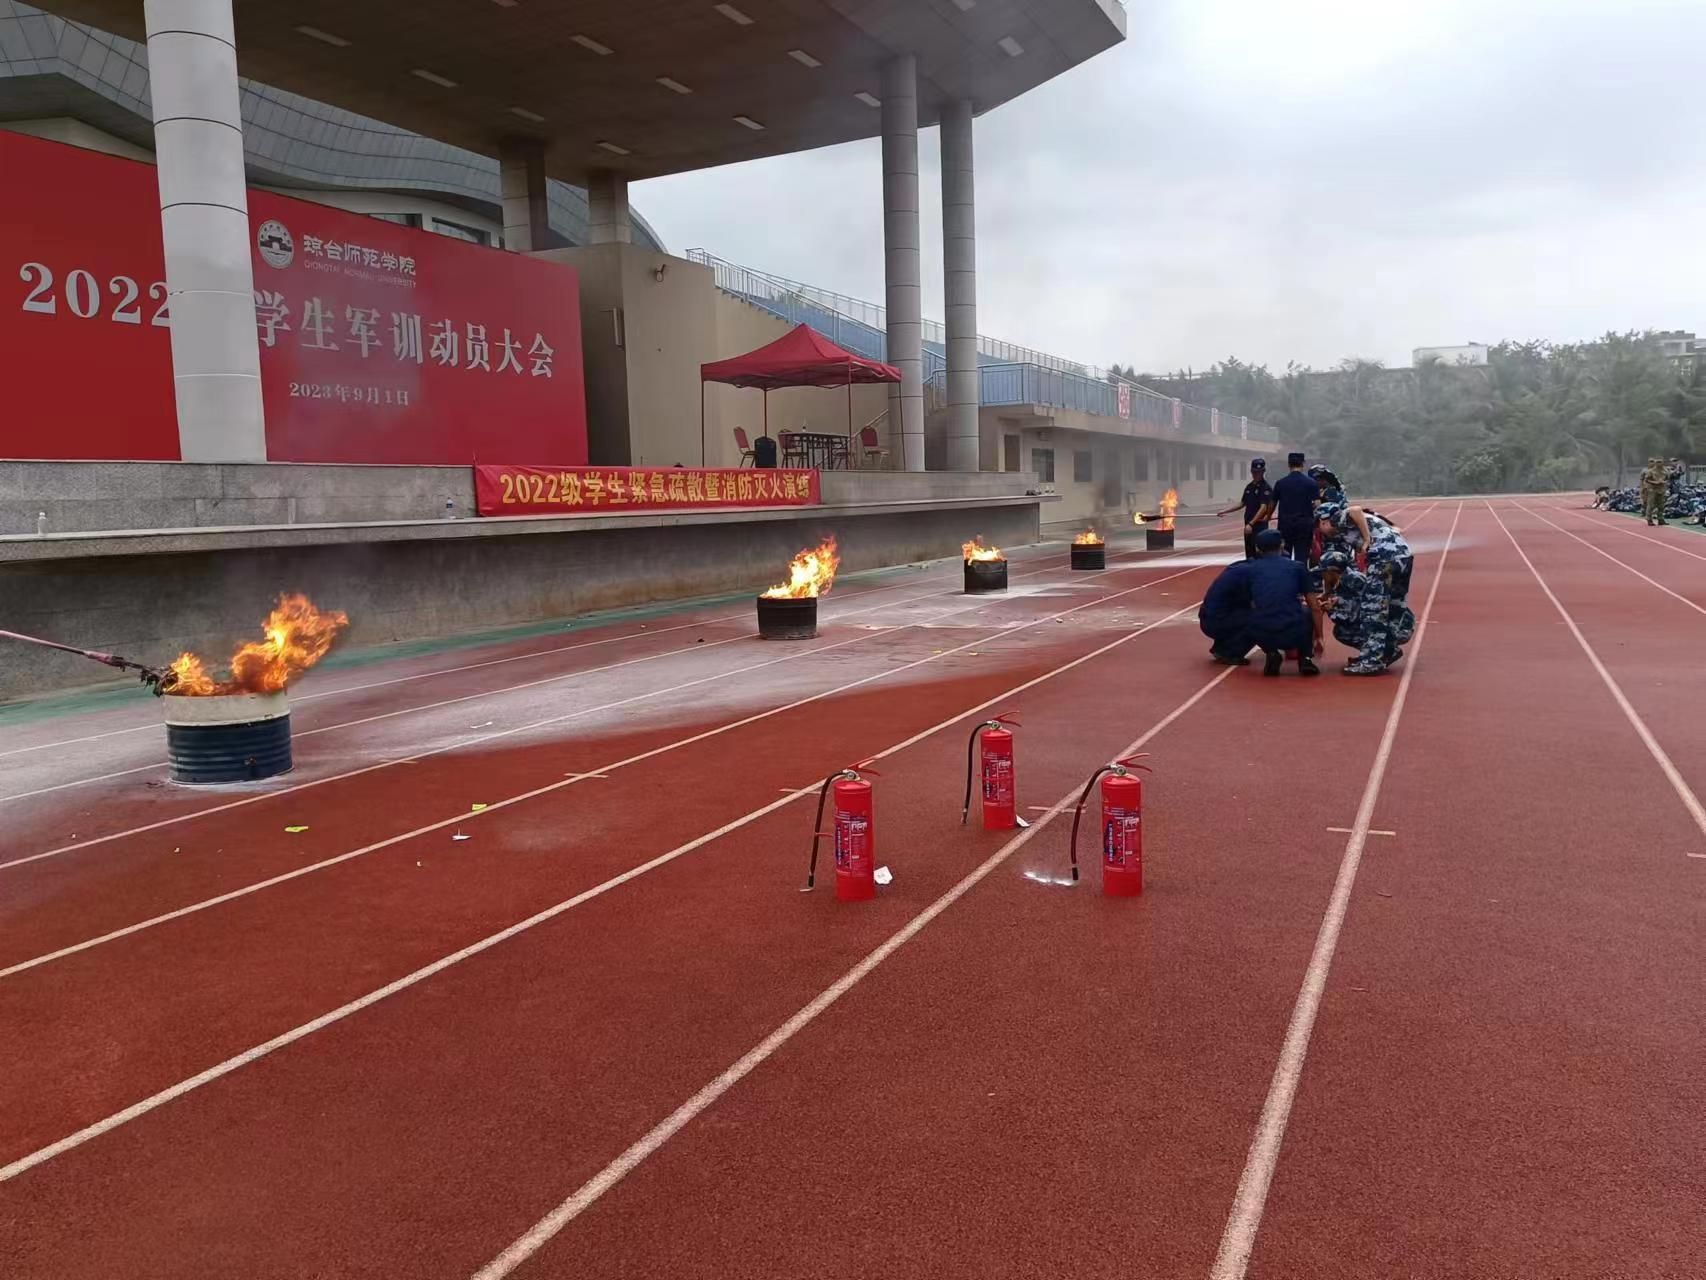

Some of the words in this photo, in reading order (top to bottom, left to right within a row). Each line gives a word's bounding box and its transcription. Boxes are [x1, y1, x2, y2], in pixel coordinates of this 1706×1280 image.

[304, 235, 416, 275] 琼台师范学院
[253, 289, 554, 378] 学生军训动员大会
[289, 382, 409, 406] 2023年9月1日
